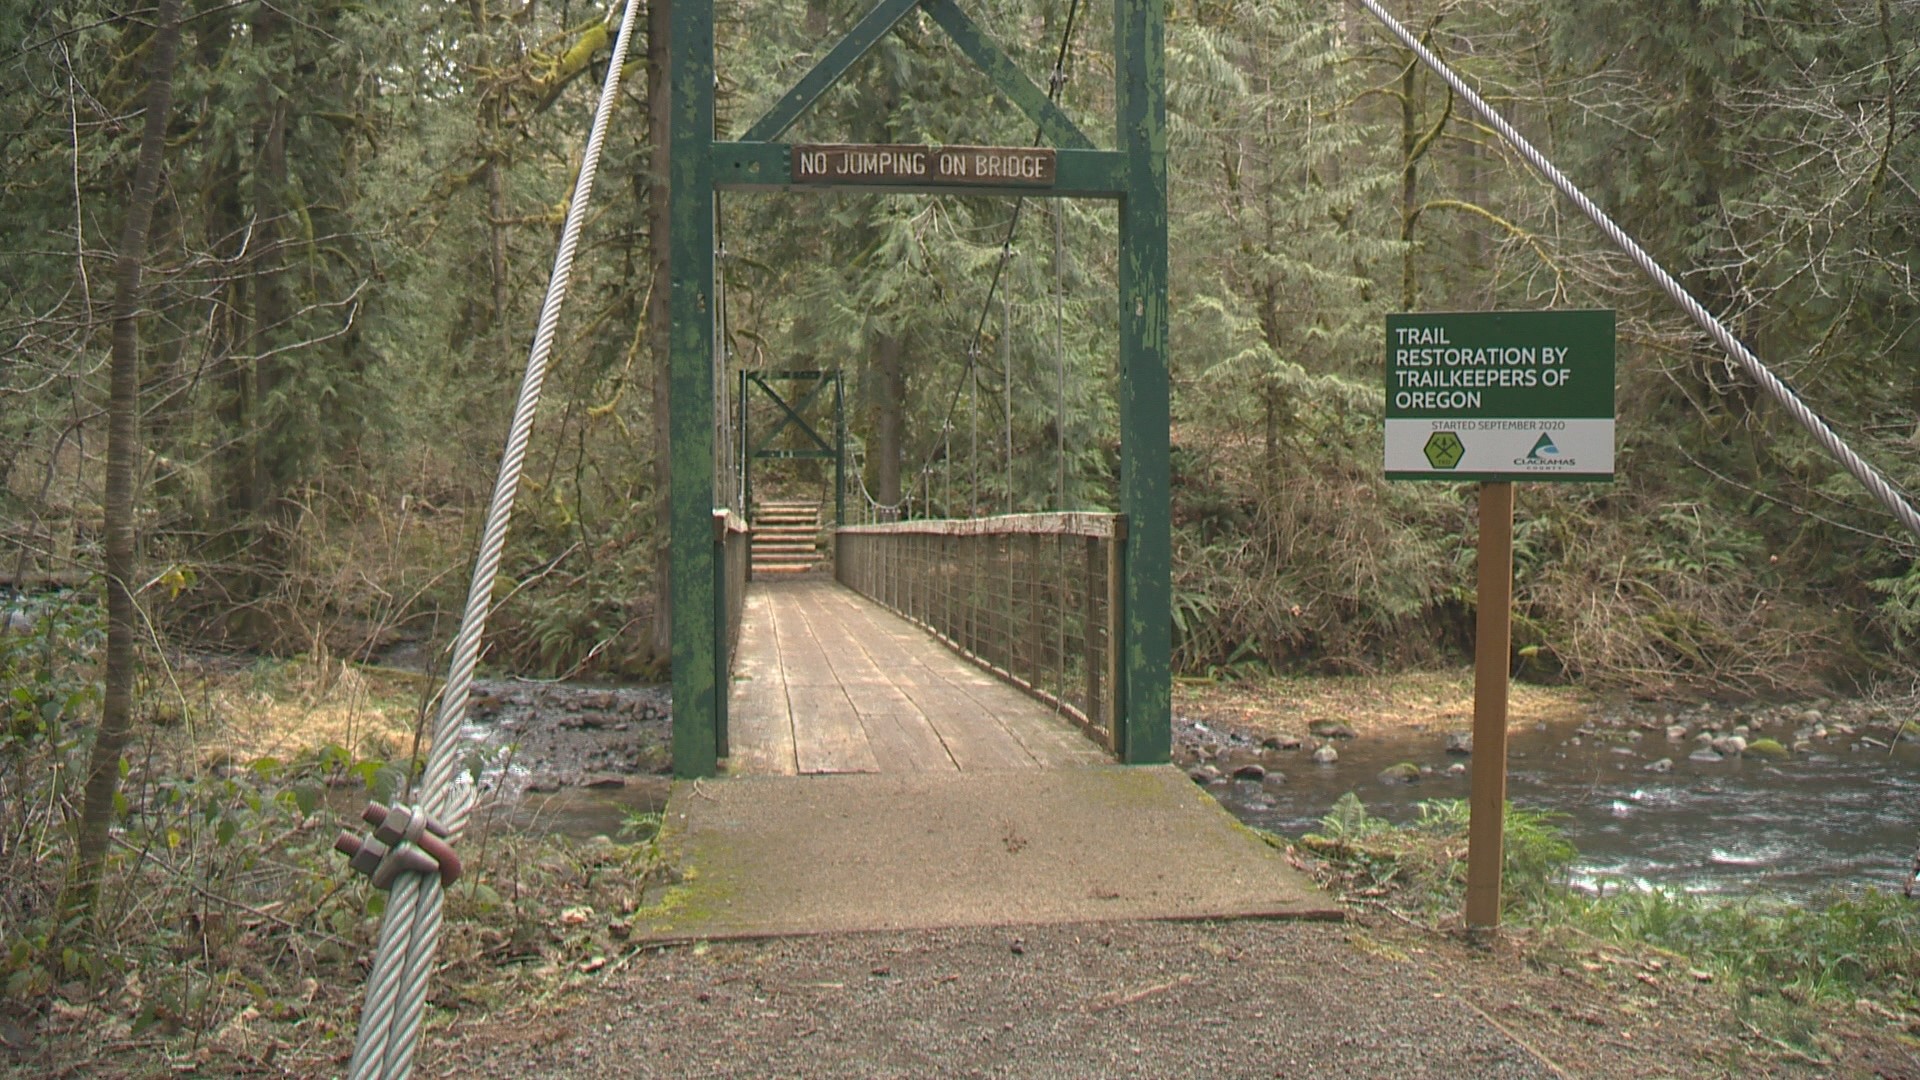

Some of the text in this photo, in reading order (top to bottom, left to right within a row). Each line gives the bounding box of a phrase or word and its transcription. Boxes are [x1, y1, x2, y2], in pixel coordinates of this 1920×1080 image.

[800, 152, 1047, 178] NO JUMPING ON BRIDGE
[1396, 328, 1450, 345] TRAIL
[1396, 347, 1568, 366] RESTORATION BY
[1396, 369, 1571, 387] TRAILKEEPERS OF
[1395, 391, 1481, 409] OREGON
[1432, 421, 1565, 430] STARTED SEPTEMBER 2020
[1513, 458, 1576, 466] CLACKAMAS
